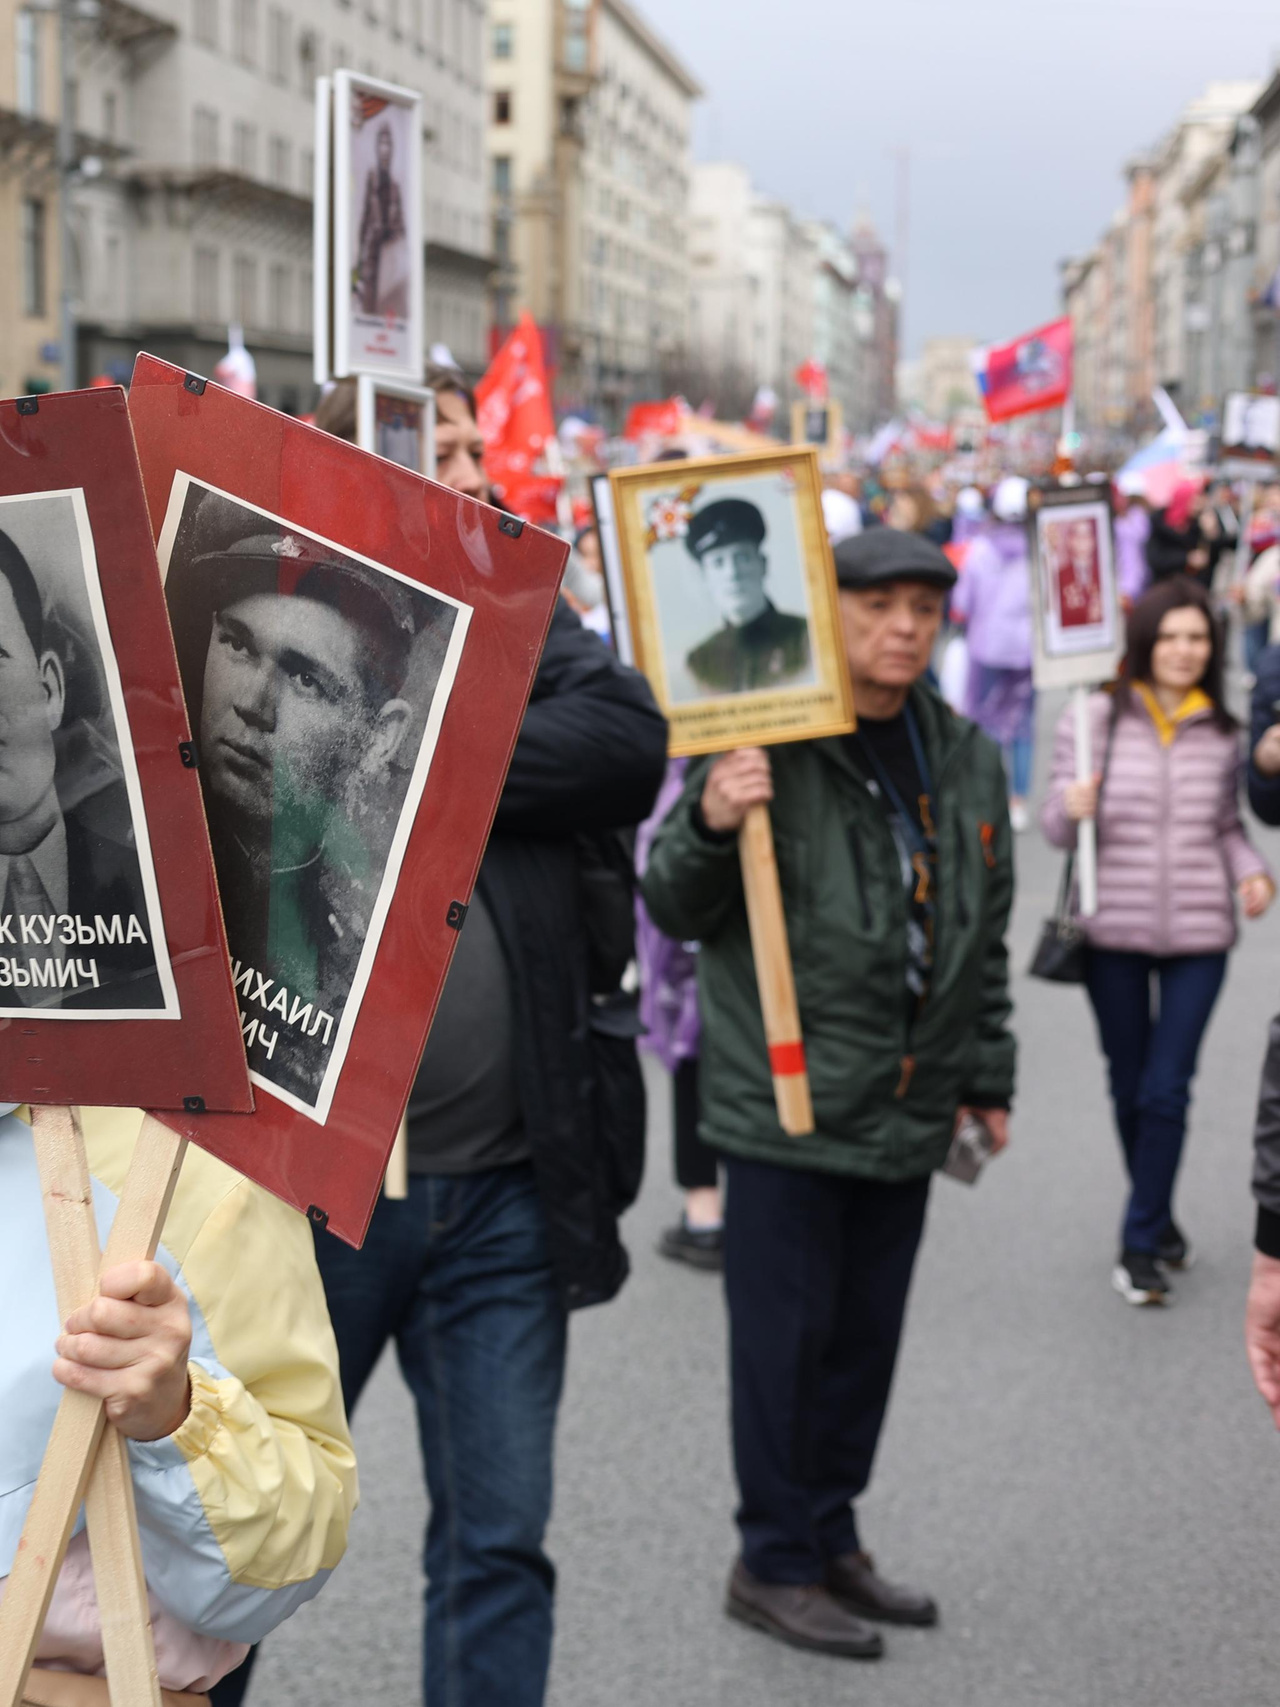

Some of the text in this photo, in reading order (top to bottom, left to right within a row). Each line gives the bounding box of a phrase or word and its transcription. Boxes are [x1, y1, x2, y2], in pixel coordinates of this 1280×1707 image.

[19, 914, 148, 945] КУЗЬМА
[229, 956, 334, 1046] ИХАИЛ
[239, 1011, 279, 1060] ИЧ
